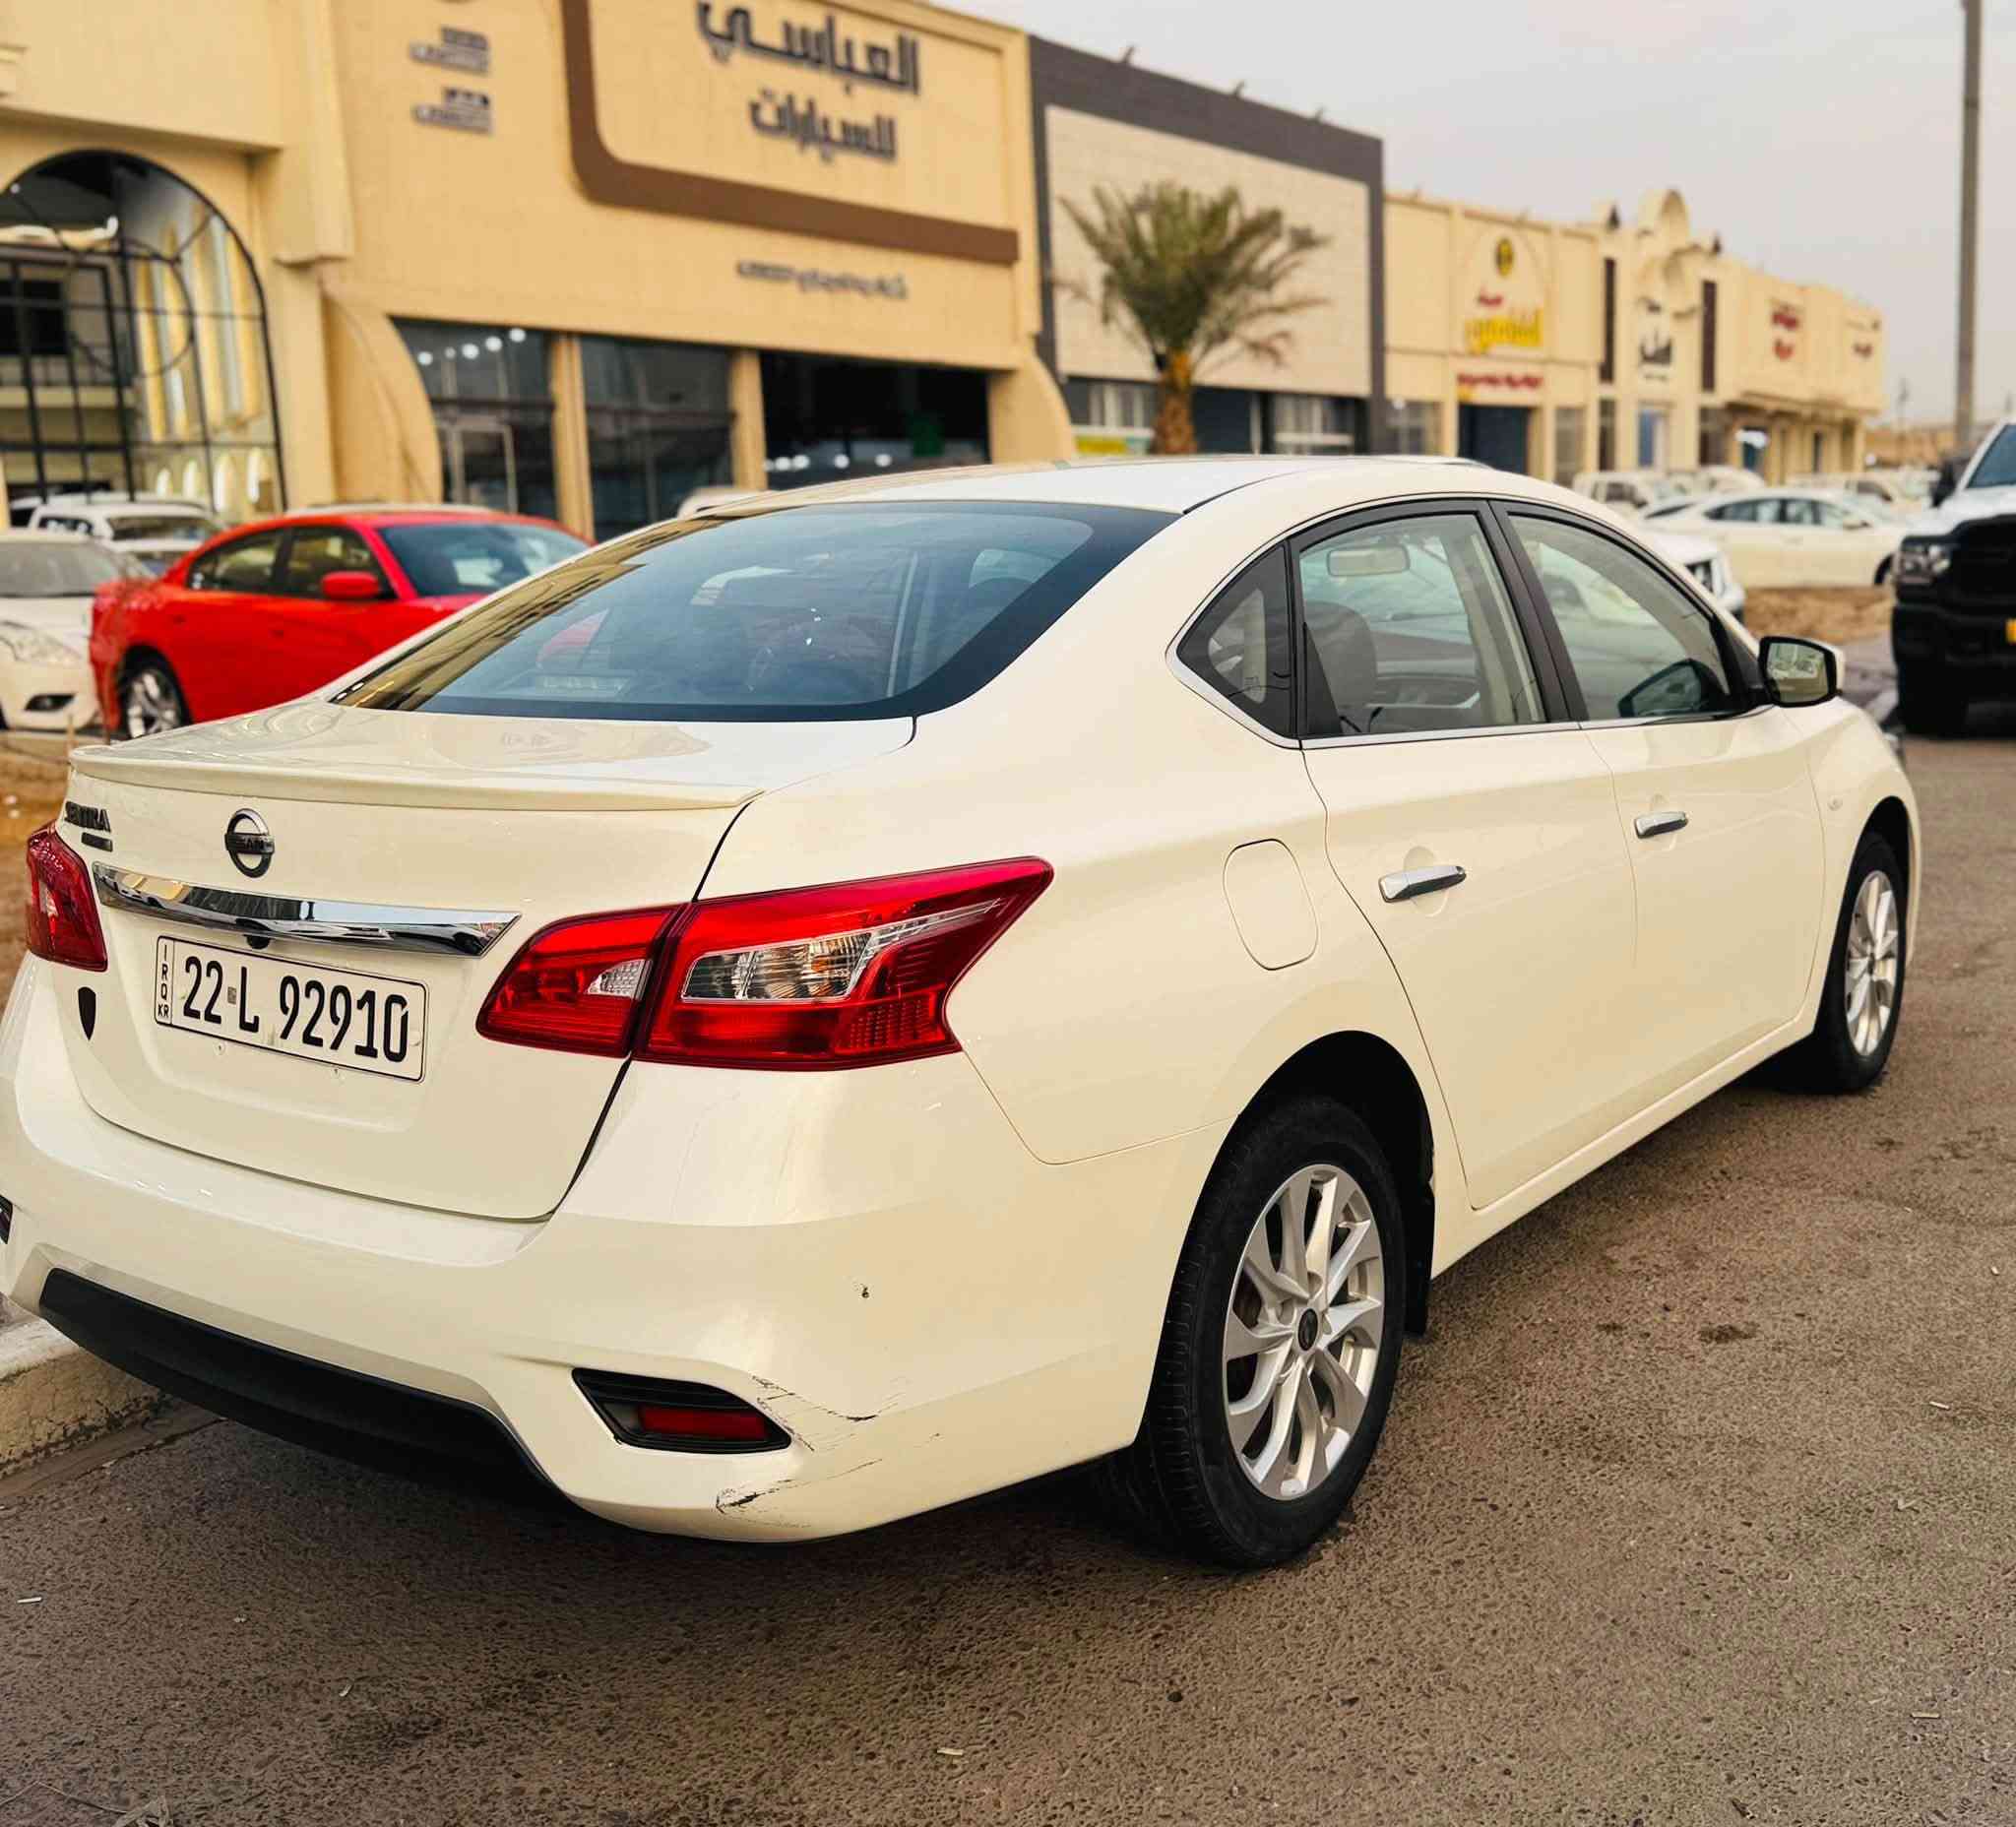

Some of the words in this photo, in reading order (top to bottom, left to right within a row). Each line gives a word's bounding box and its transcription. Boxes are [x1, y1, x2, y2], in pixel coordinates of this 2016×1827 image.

[697, 0, 919, 96] العباسي
[749, 88, 897, 163] للسيارات
[183, 956, 223, 1025] 22
[238, 966, 260, 1033] L
[280, 975, 410, 1063] 92910
